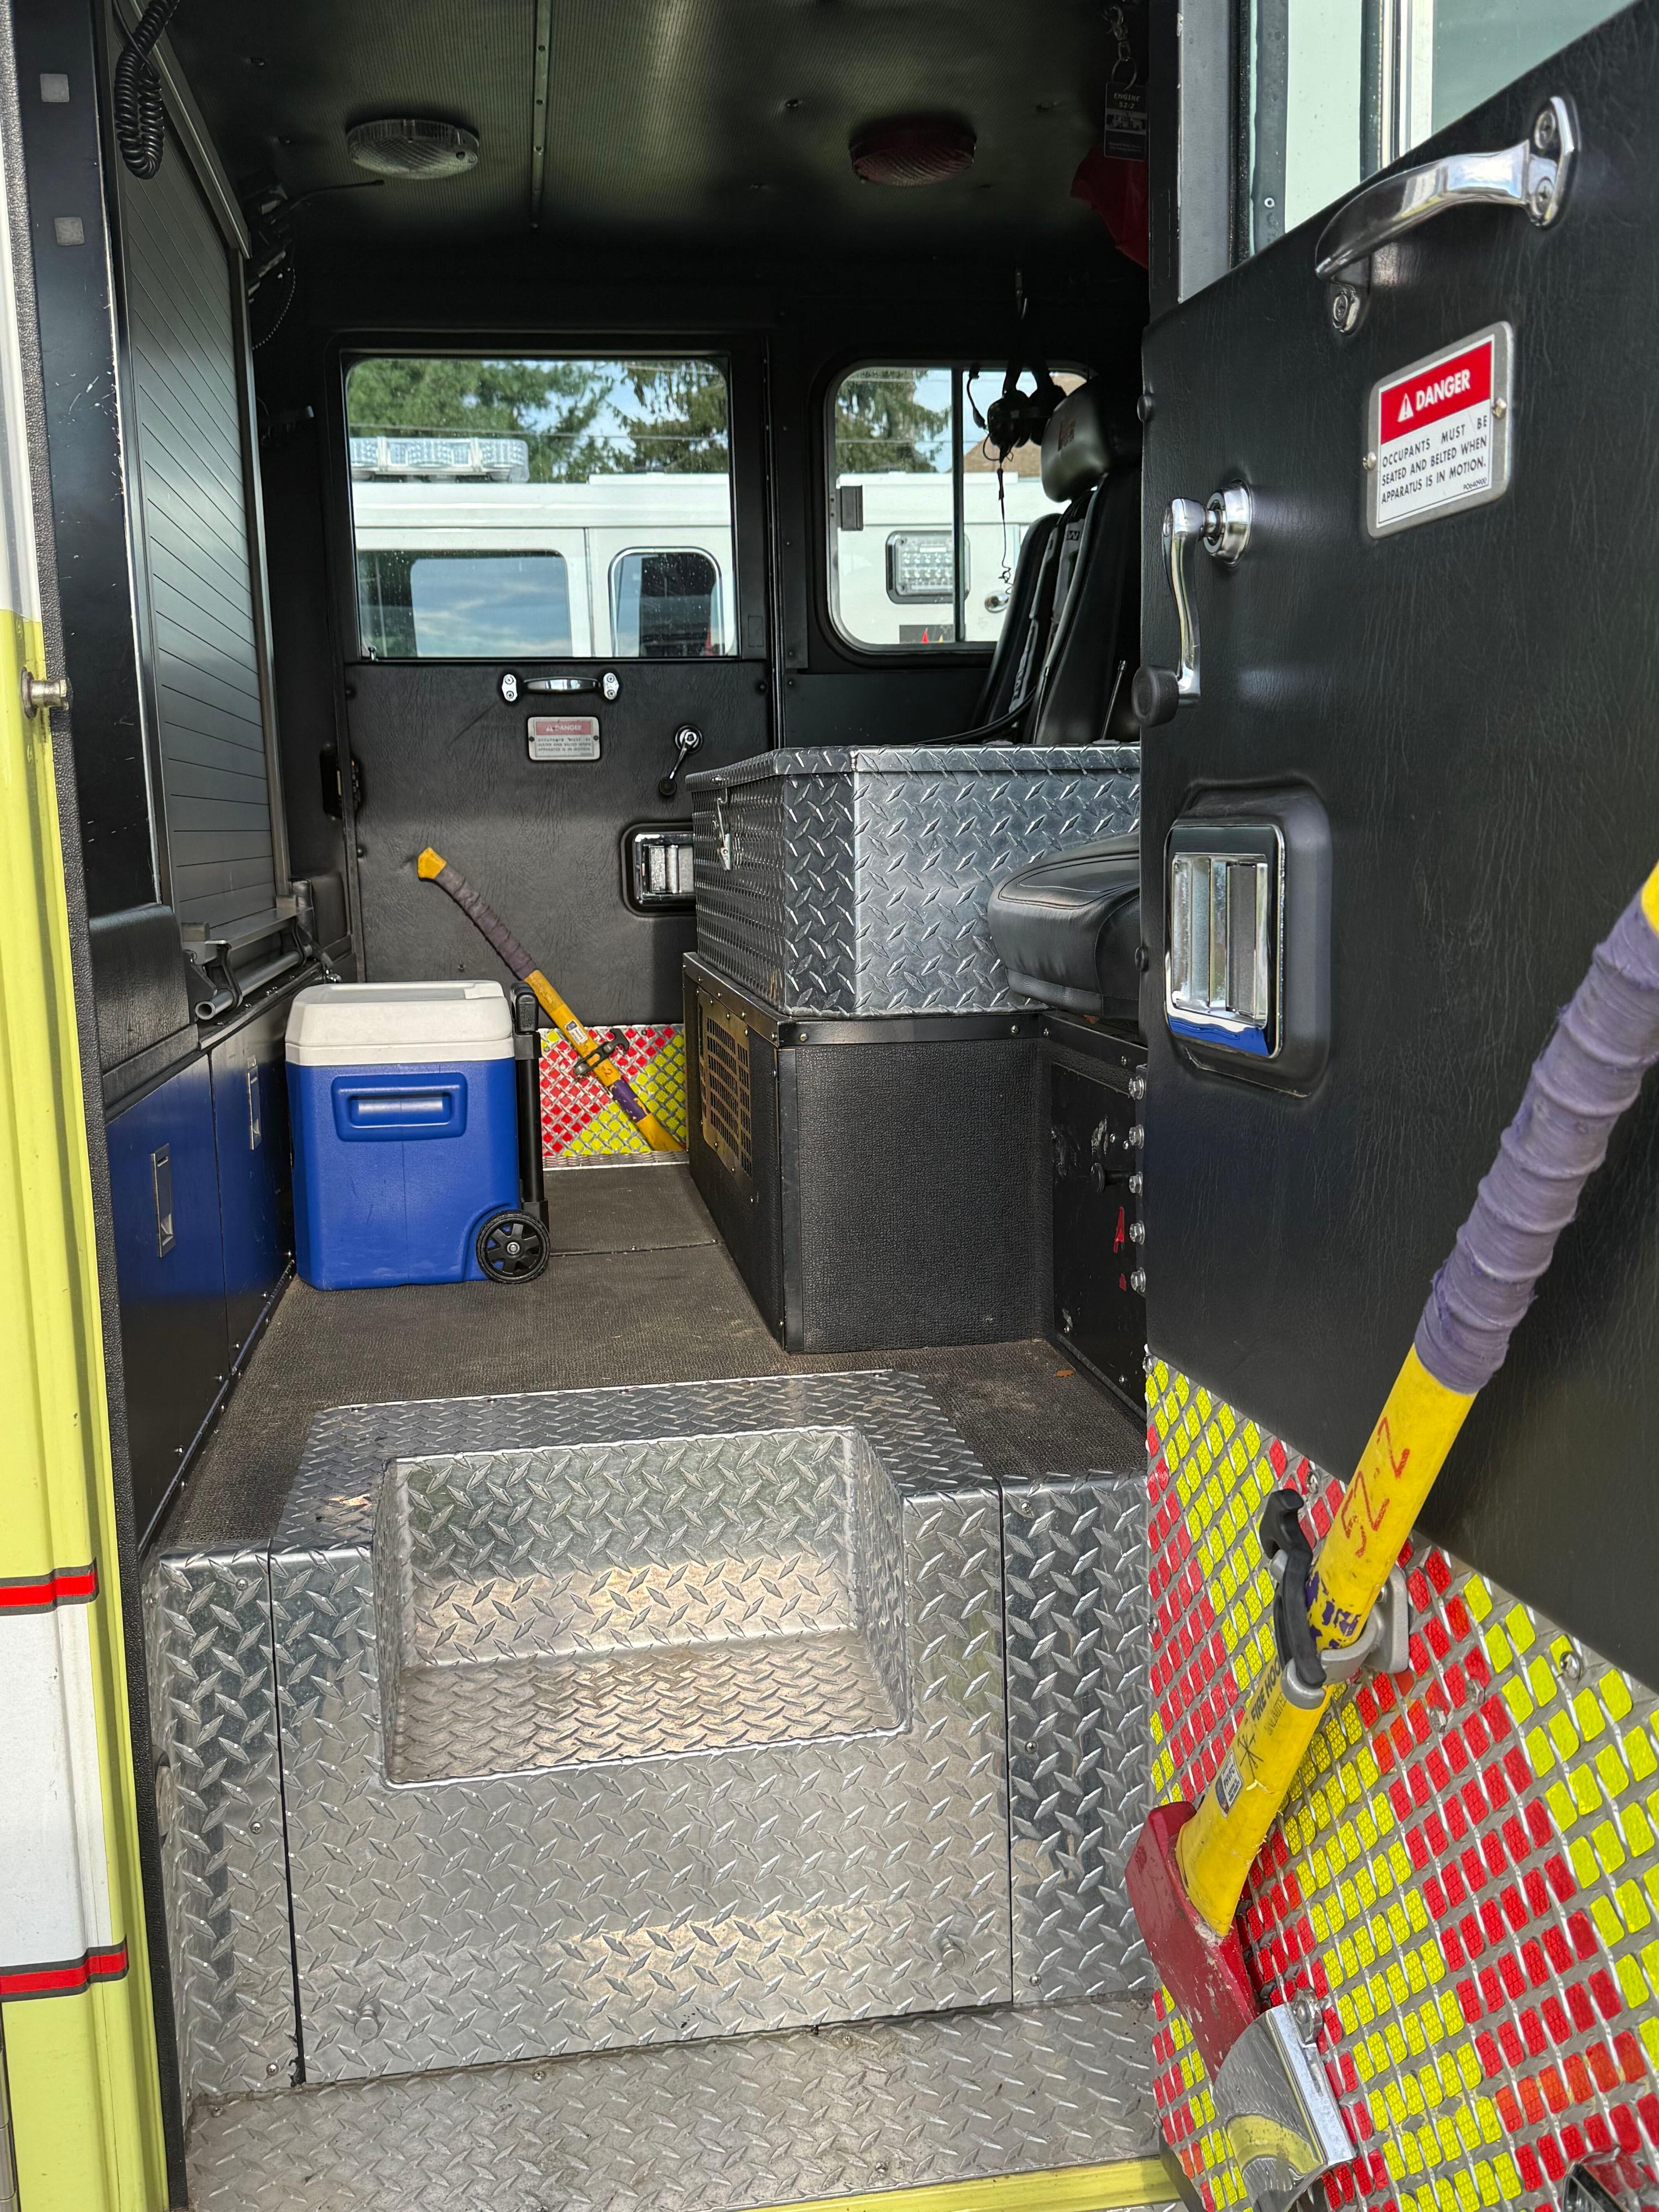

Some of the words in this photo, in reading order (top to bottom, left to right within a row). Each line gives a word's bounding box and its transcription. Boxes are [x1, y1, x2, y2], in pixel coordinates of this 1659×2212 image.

[1416, 369, 1471, 411] DANGER
[1382, 467, 1407, 486] SEATED
[1410, 459, 1427, 475] AND
[1431, 447, 1457, 467] BELTED
[1460, 435, 1487, 455] WHEN
[1383, 438, 1430, 468] OCCUPANTS
[1441, 424, 1465, 444] MUST
[1477, 415, 1487, 430] BE
[1381, 478, 1422, 504] APPARATUS
[1426, 474, 1433, 487] IS
[1437, 469, 1446, 484] IN
[1449, 456, 1486, 479] MOTION.
[1251, 1688, 1266, 1722] FIRE
[1265, 1655, 1281, 1698] HOO
